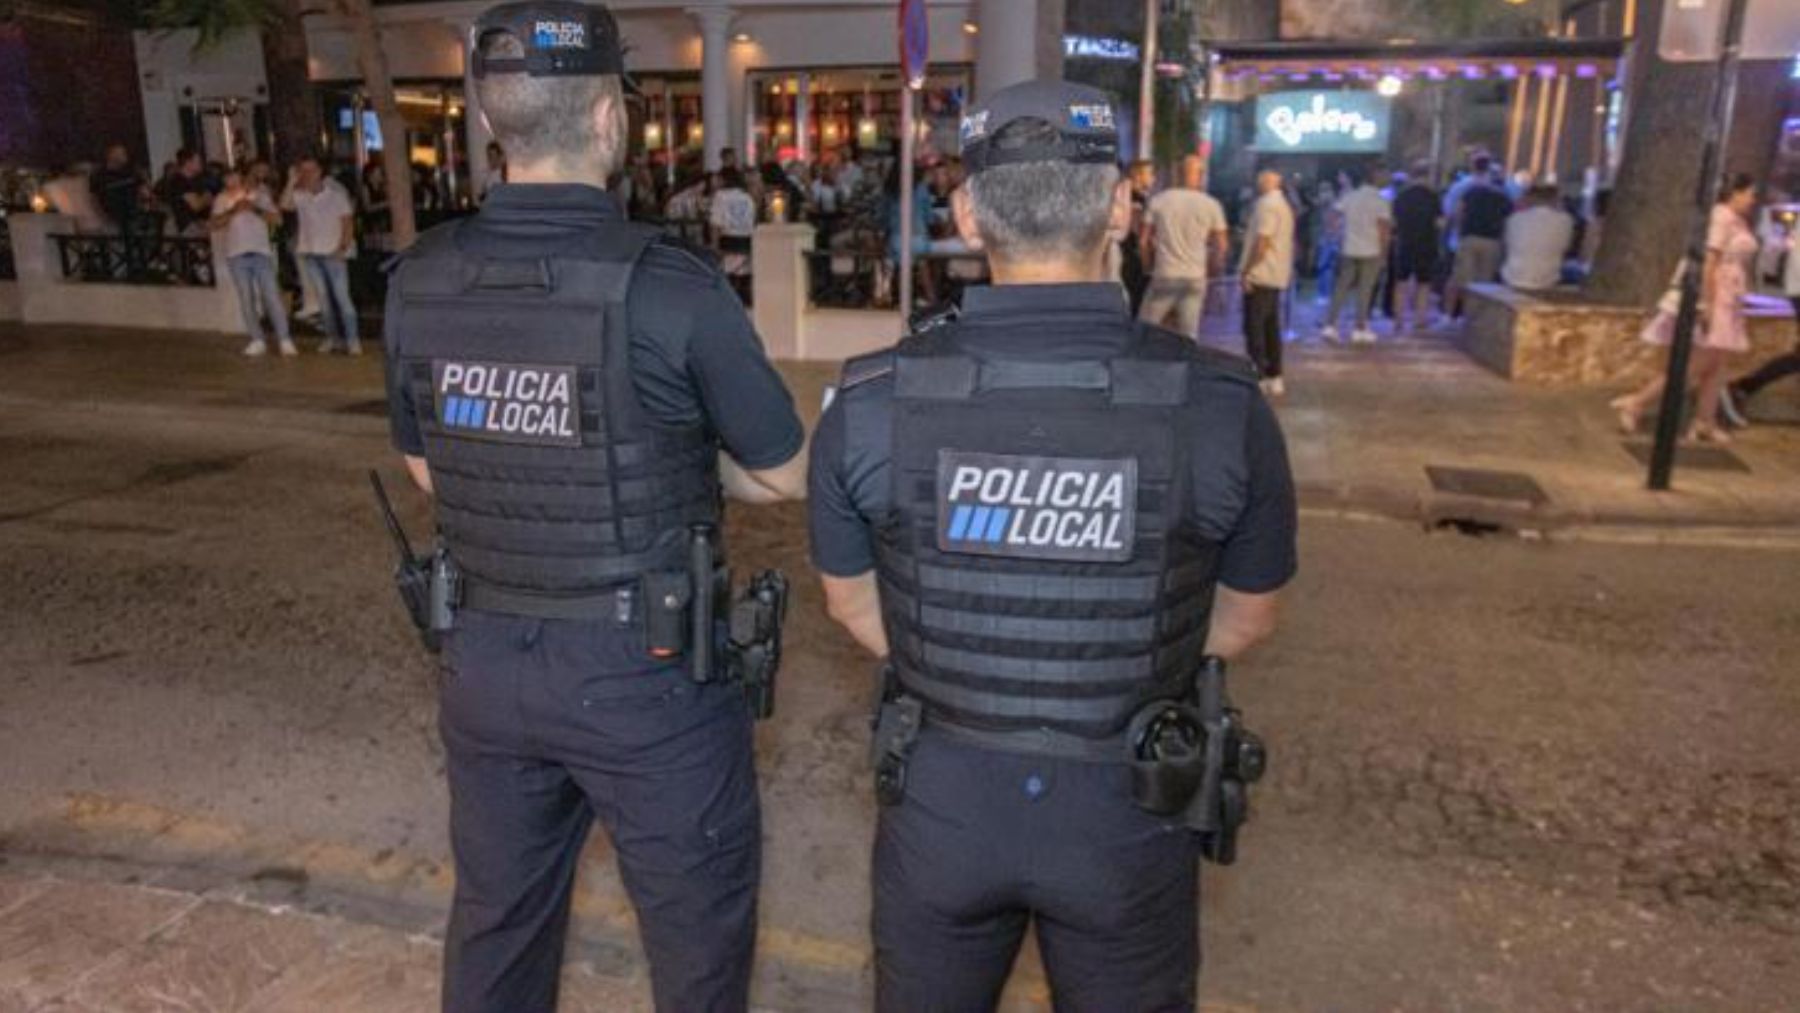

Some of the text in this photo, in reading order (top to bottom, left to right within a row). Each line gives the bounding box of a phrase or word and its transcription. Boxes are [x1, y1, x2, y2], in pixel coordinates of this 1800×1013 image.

[441, 363, 570, 403] POLICIA
[486, 400, 573, 436] LOCAL
[948, 466, 1122, 509] POLICIA
[1007, 508, 1123, 549] LOCAL
